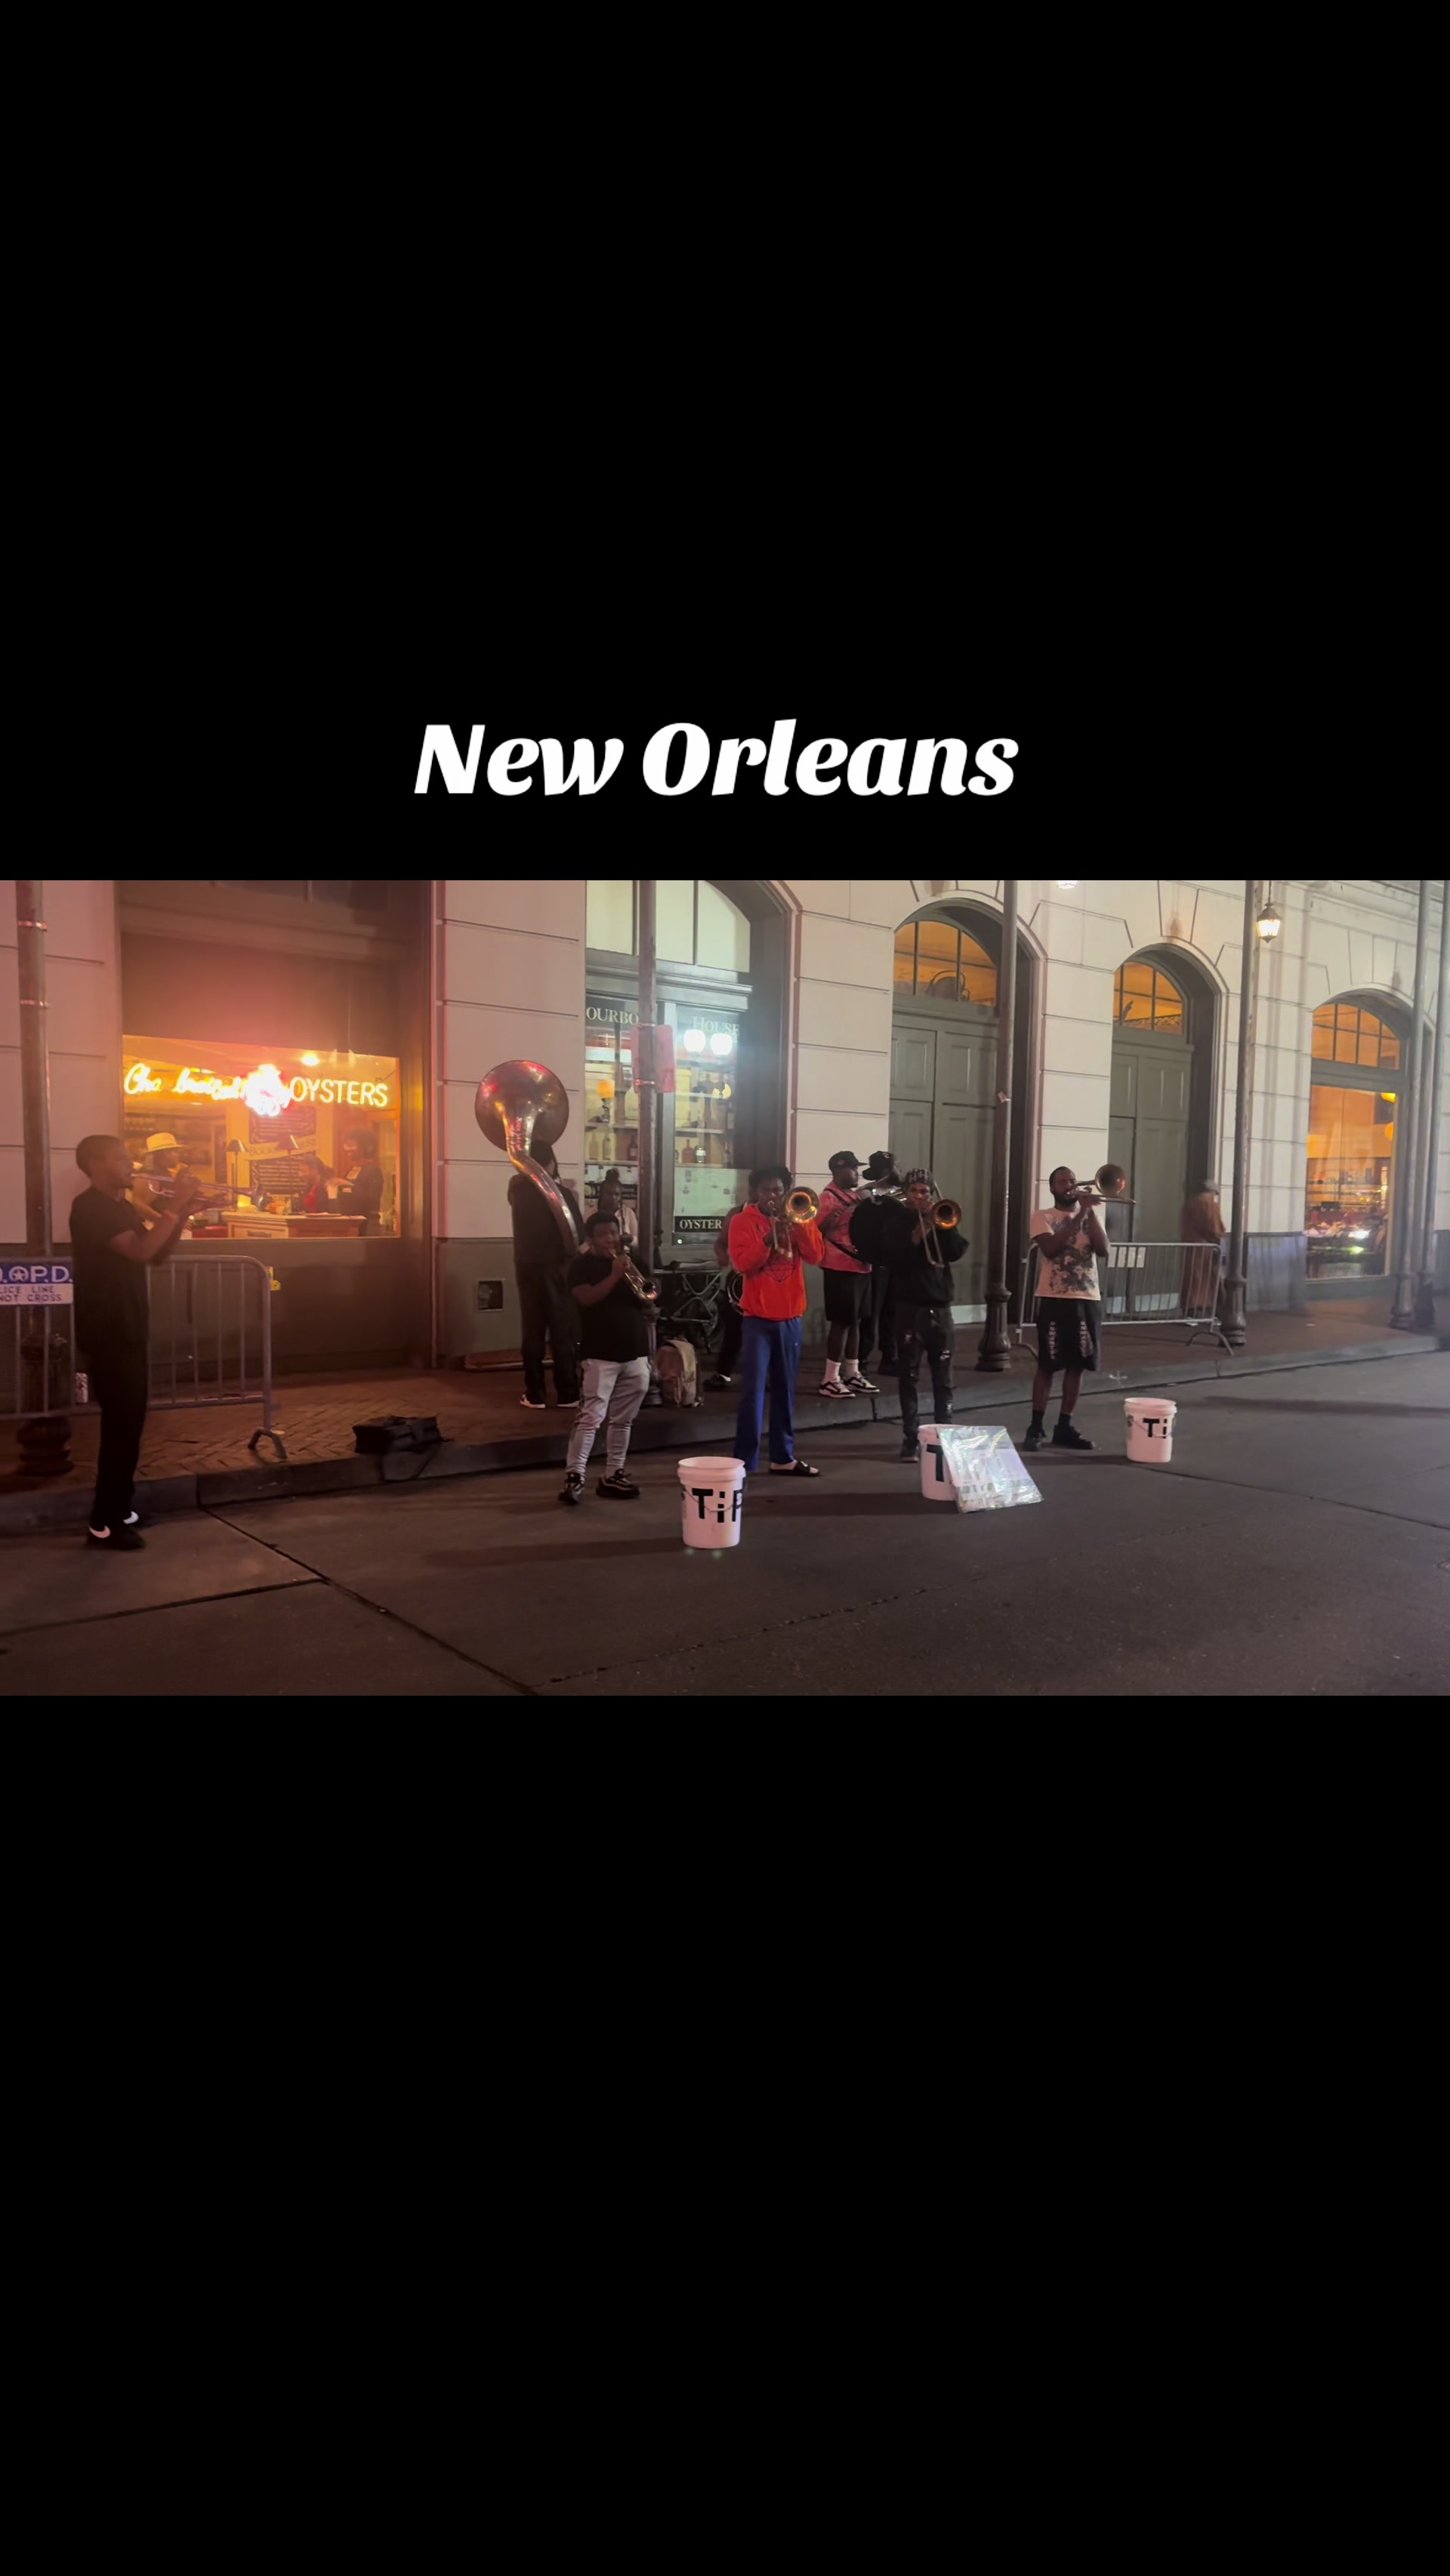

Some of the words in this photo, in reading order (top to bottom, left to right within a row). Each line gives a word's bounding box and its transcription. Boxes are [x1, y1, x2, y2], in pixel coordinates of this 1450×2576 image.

[586, 1006, 639, 1025] OURBO
[290, 1077, 388, 1108] OYSTERS
[680, 1219, 722, 1229] OYSTER
